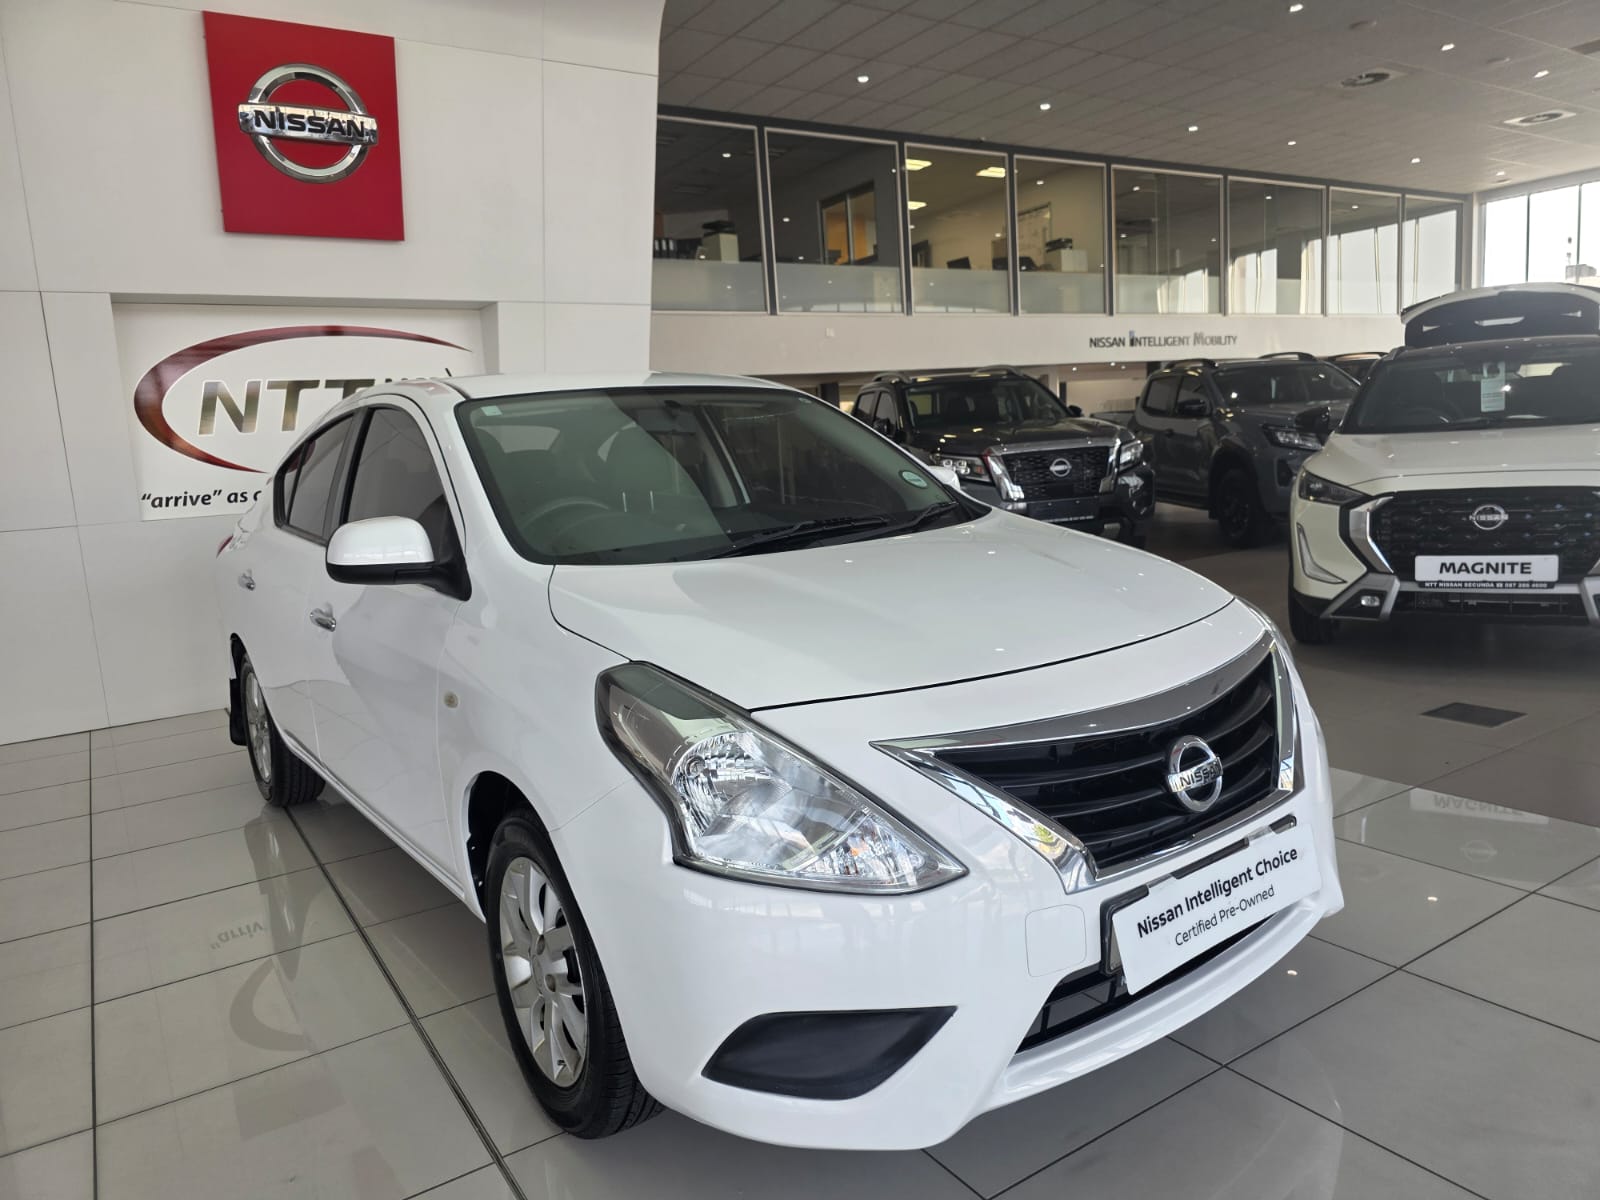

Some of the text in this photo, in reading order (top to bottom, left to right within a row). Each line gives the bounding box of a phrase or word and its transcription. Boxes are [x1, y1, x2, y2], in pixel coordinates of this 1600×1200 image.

[254, 110, 365, 137] NISSAN
[1089, 330, 1237, 348] NISSAN INTELLIGENT MOBILITY
[227, 491, 248, 503] as
[1439, 562, 1532, 574] MAGNITE
[1137, 848, 1298, 938] Nissan Intelligent Choice
[1175, 884, 1275, 946] Certified Pre-Owned
